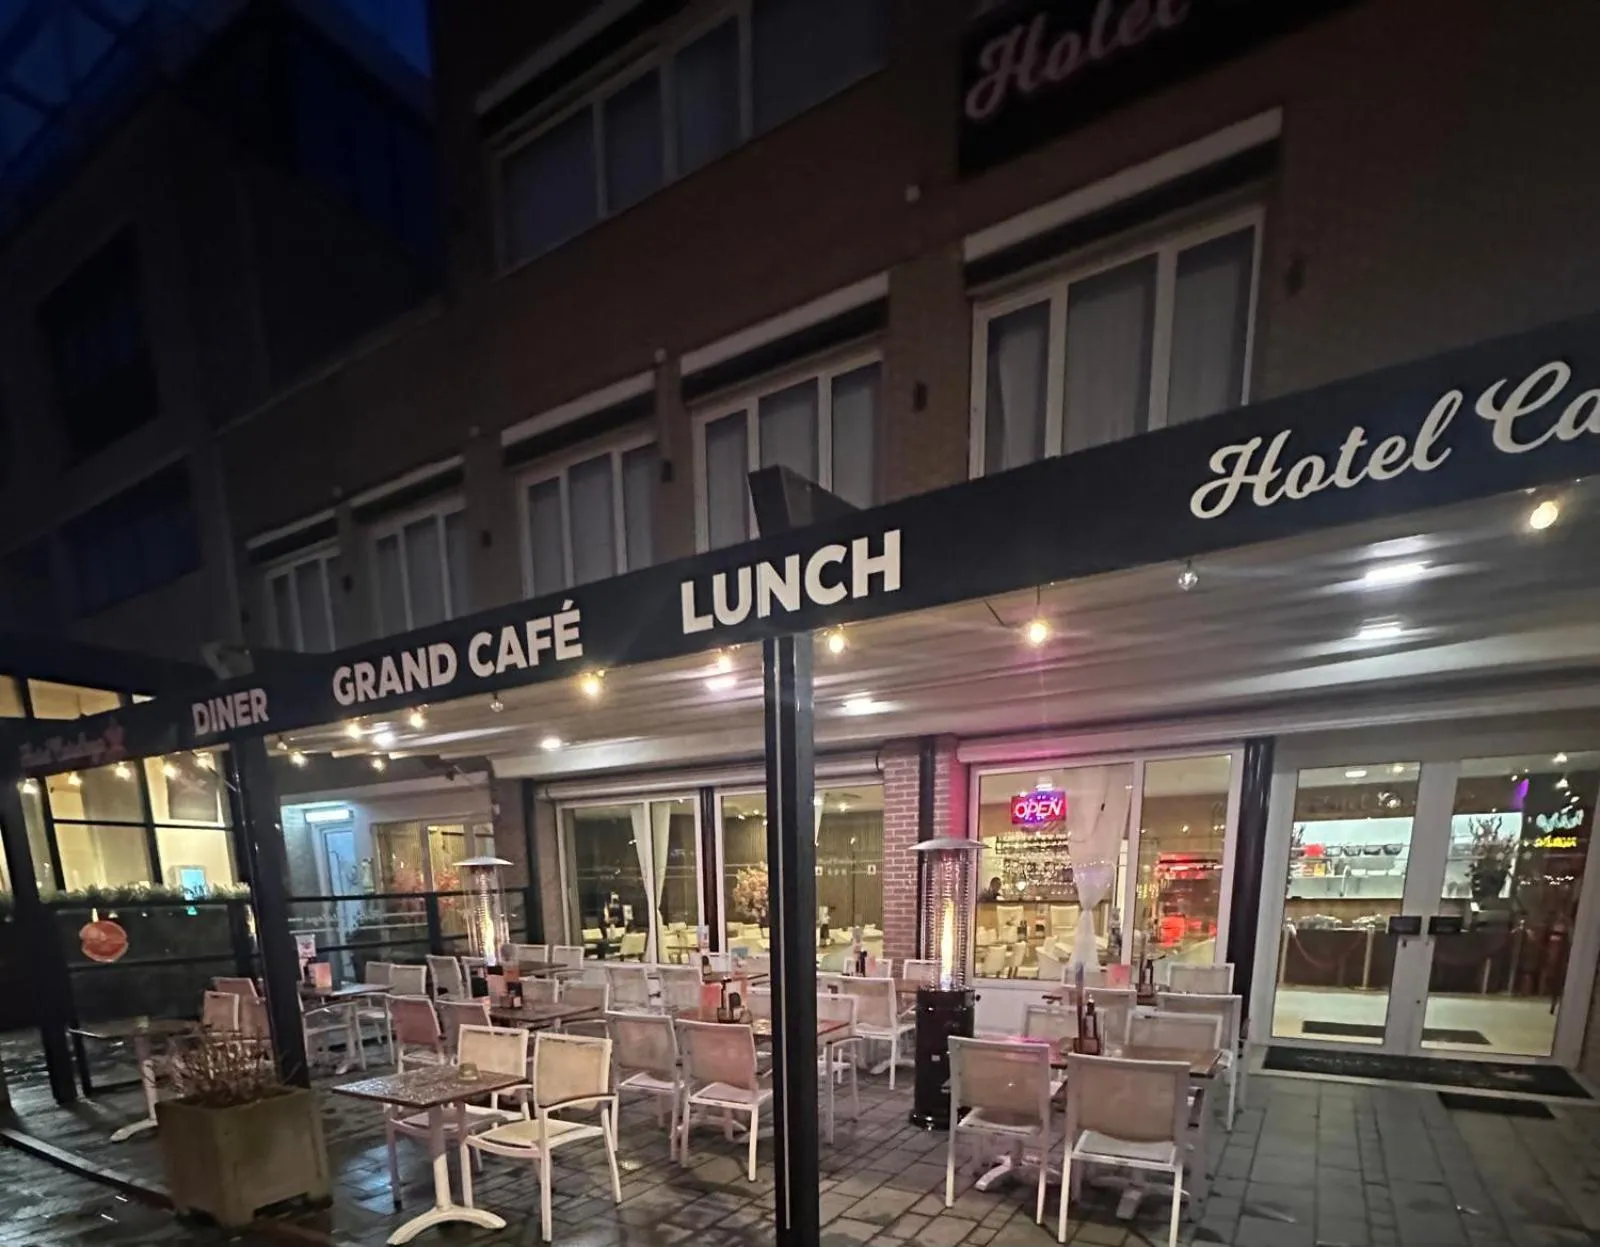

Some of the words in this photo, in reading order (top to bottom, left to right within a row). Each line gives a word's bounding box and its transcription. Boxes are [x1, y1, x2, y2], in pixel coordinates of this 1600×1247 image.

[965, 0, 1190, 119] Hote
[1189, 389, 1463, 519] Hotel
[680, 529, 901, 635] LUNCH
[332, 642, 458, 706] GRAND
[467, 599, 584, 678] CAFÉ
[191, 688, 269, 736] DINER
[1015, 799, 1063, 819] OPEN
